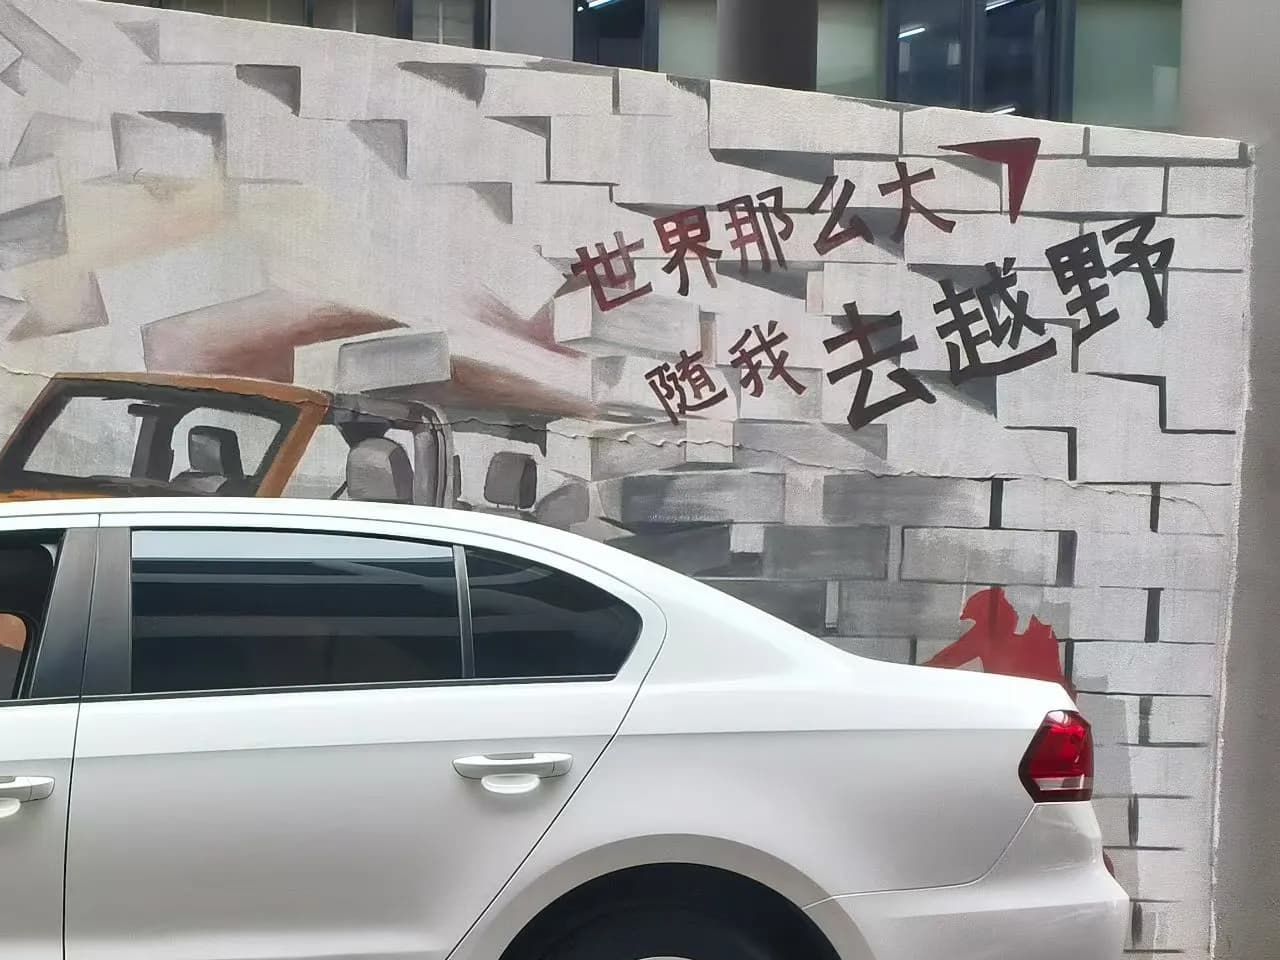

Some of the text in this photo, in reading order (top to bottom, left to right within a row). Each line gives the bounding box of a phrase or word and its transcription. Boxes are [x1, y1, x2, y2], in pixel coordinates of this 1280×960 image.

[570, 160, 956, 312] 世界那么大
